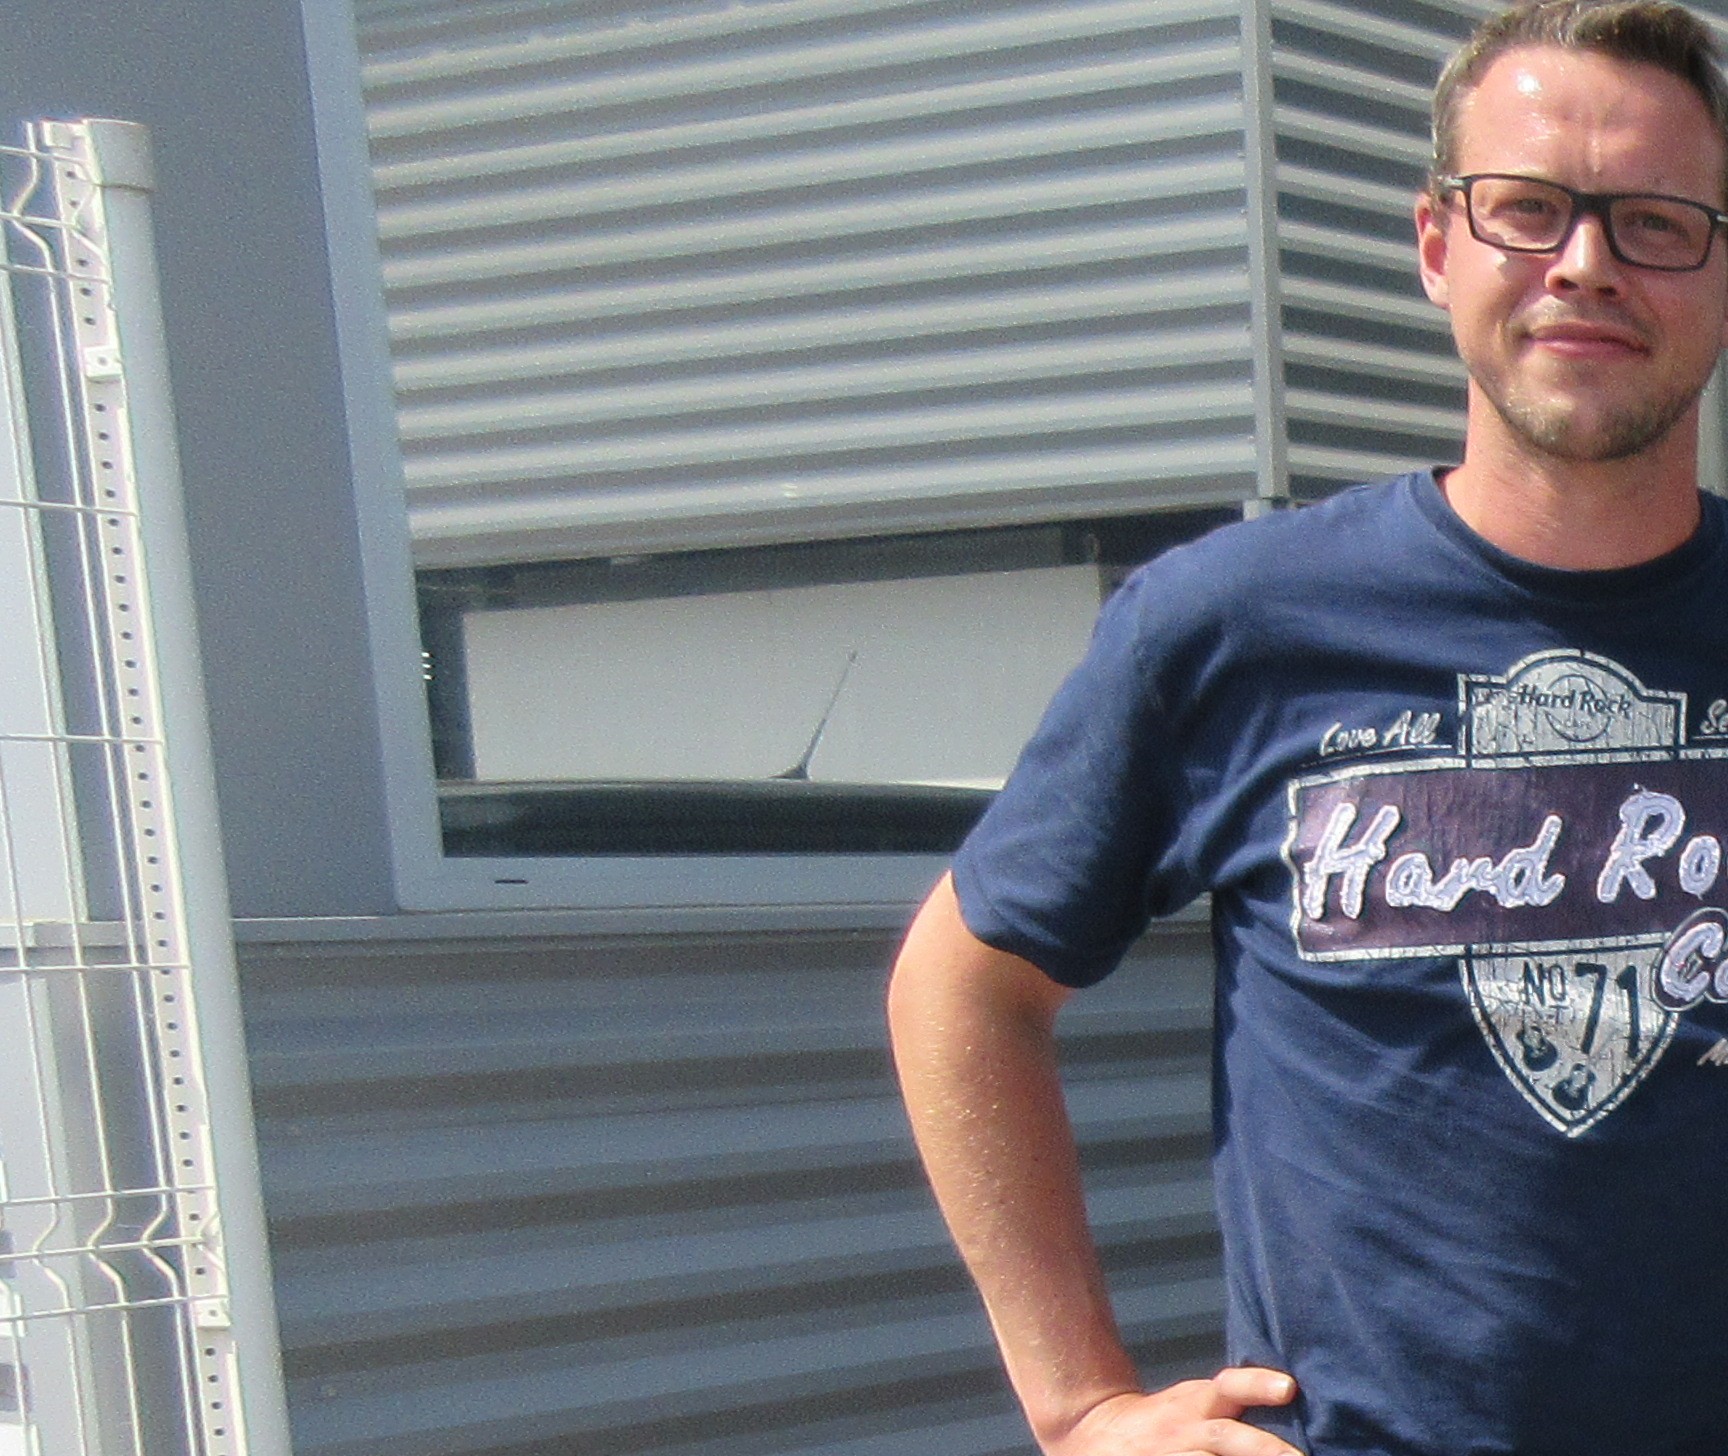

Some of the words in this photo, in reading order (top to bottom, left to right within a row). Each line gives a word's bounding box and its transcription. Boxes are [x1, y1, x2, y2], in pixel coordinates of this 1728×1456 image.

[1320, 720, 1377, 756] Love
[1383, 709, 1441, 746] All
[1514, 684, 1576, 708] Hard
[1579, 689, 1632, 720] Rock
[1304, 803, 1566, 919] Hard
[1574, 961, 1640, 1062] 71
